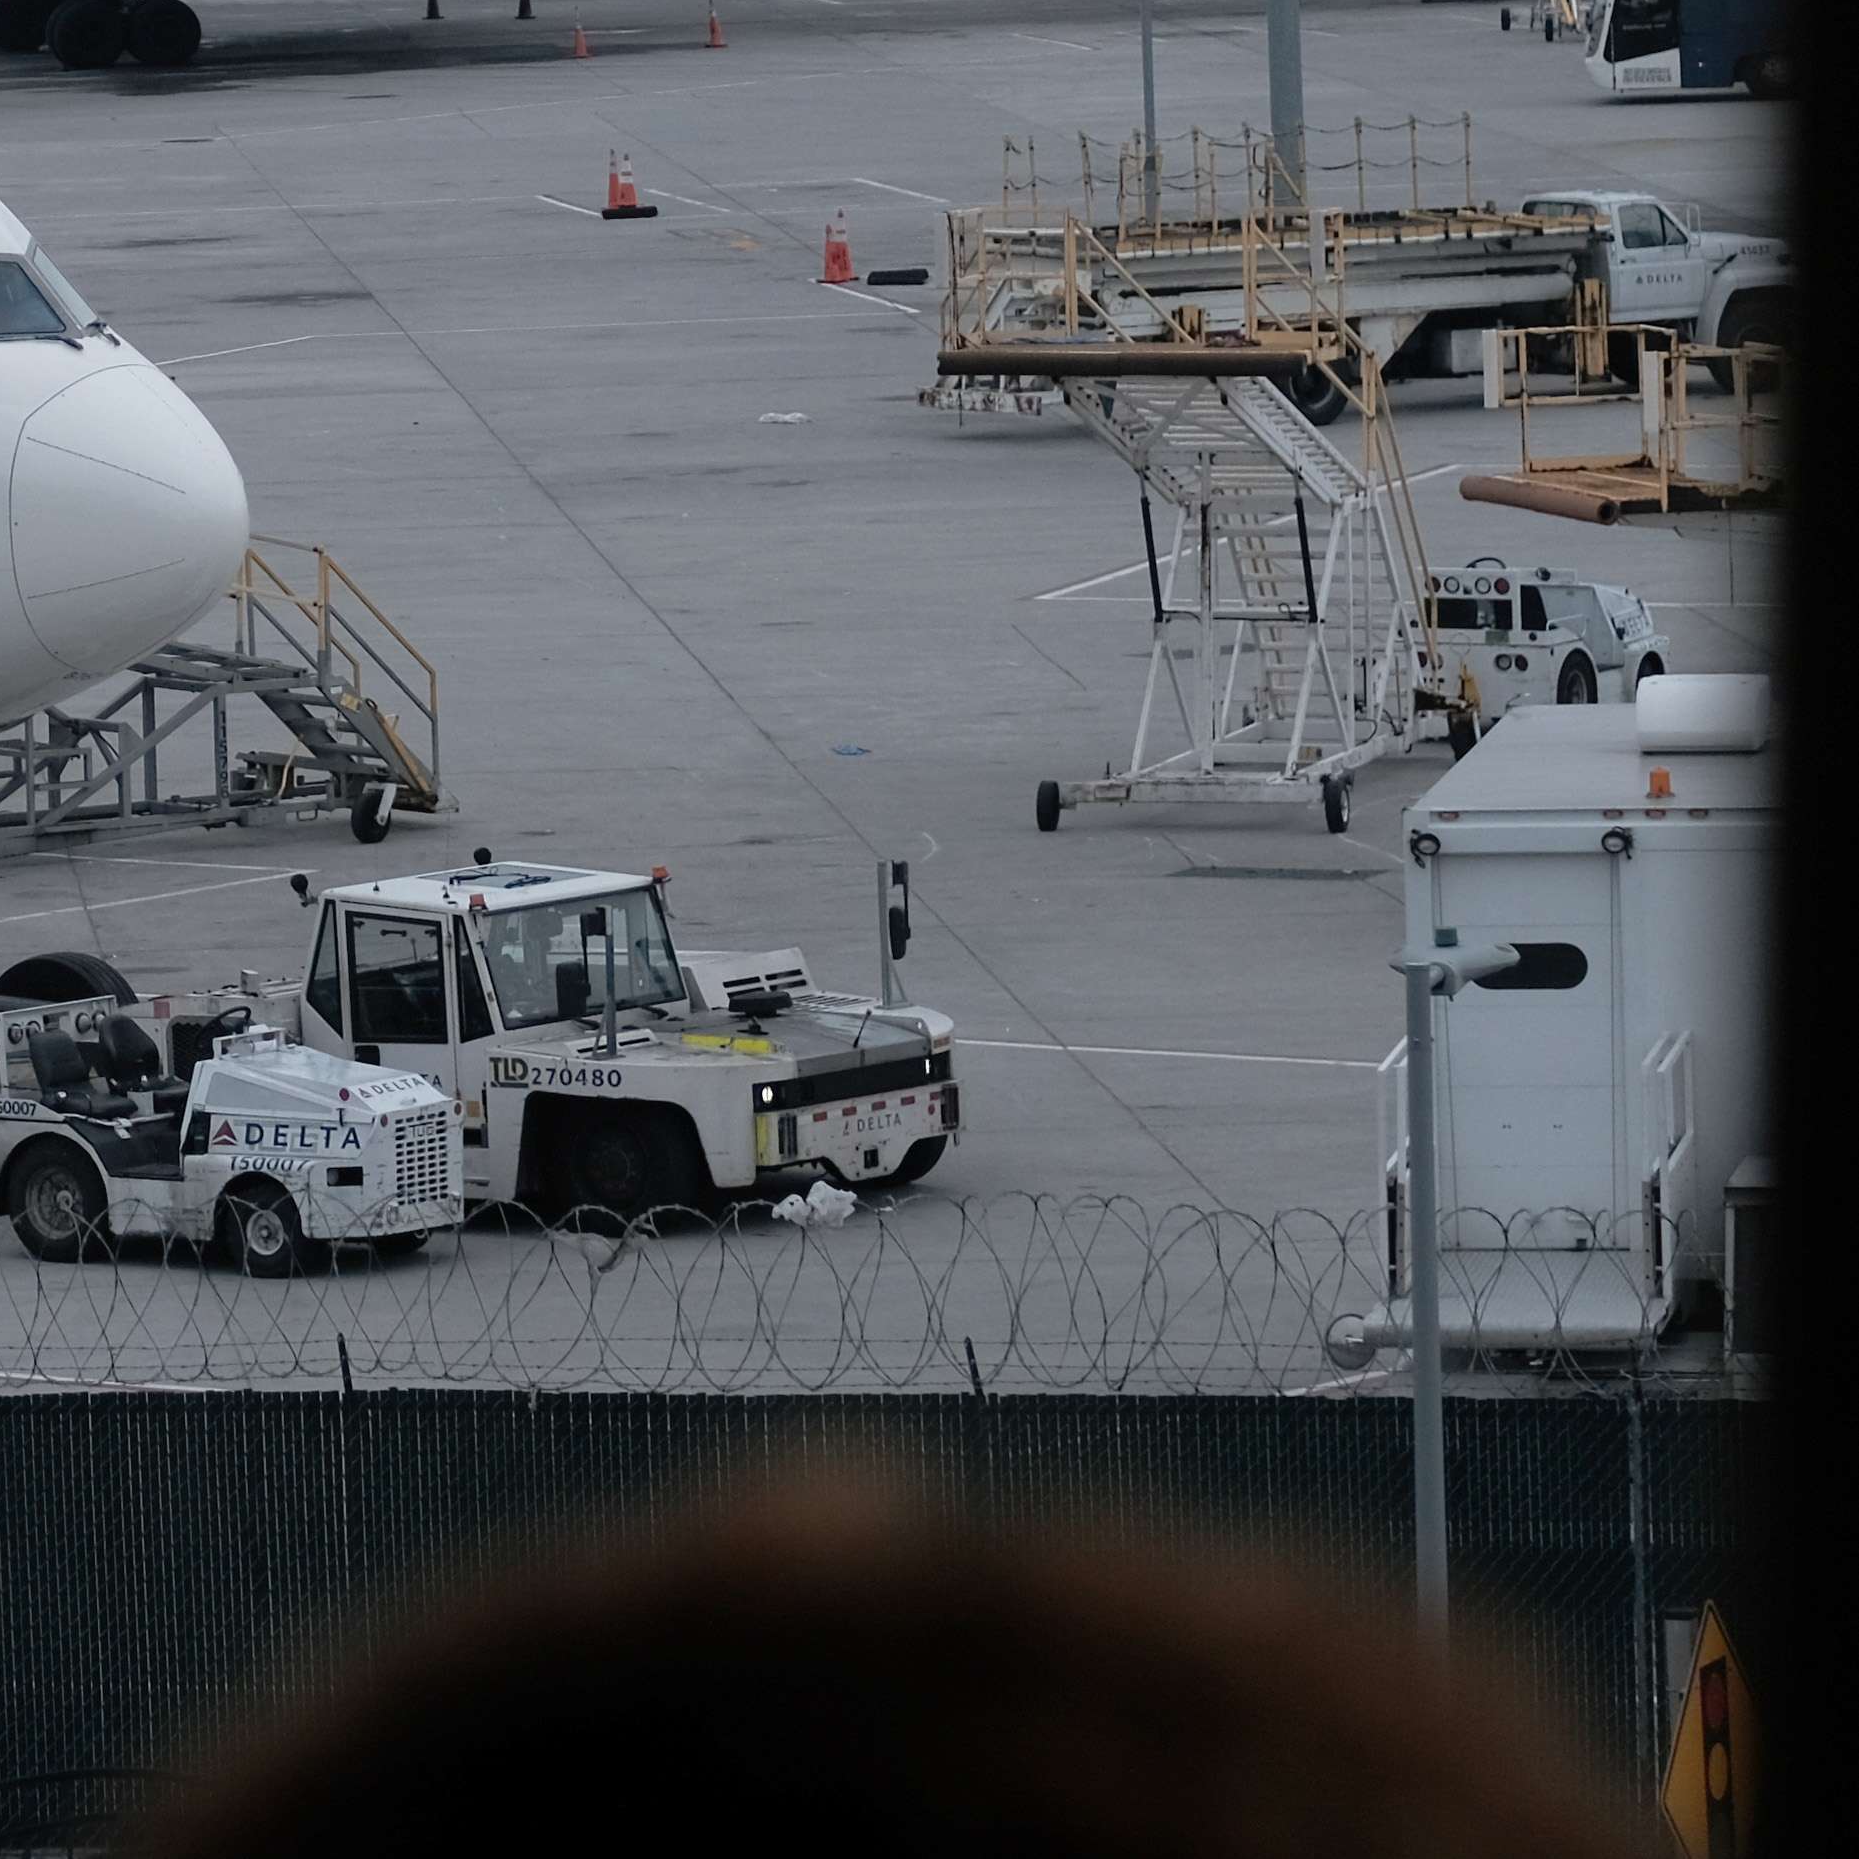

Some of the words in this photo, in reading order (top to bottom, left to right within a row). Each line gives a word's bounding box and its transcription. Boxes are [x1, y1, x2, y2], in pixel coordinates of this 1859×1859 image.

[1645, 273, 1683, 284] DELTA
[489, 1056, 529, 1088] TLD
[531, 1066, 622, 1088] 270480
[372, 1075, 424, 1095] DELTA
[857, 1111, 903, 1132] DELTA
[244, 1122, 362, 1150] DELTA
